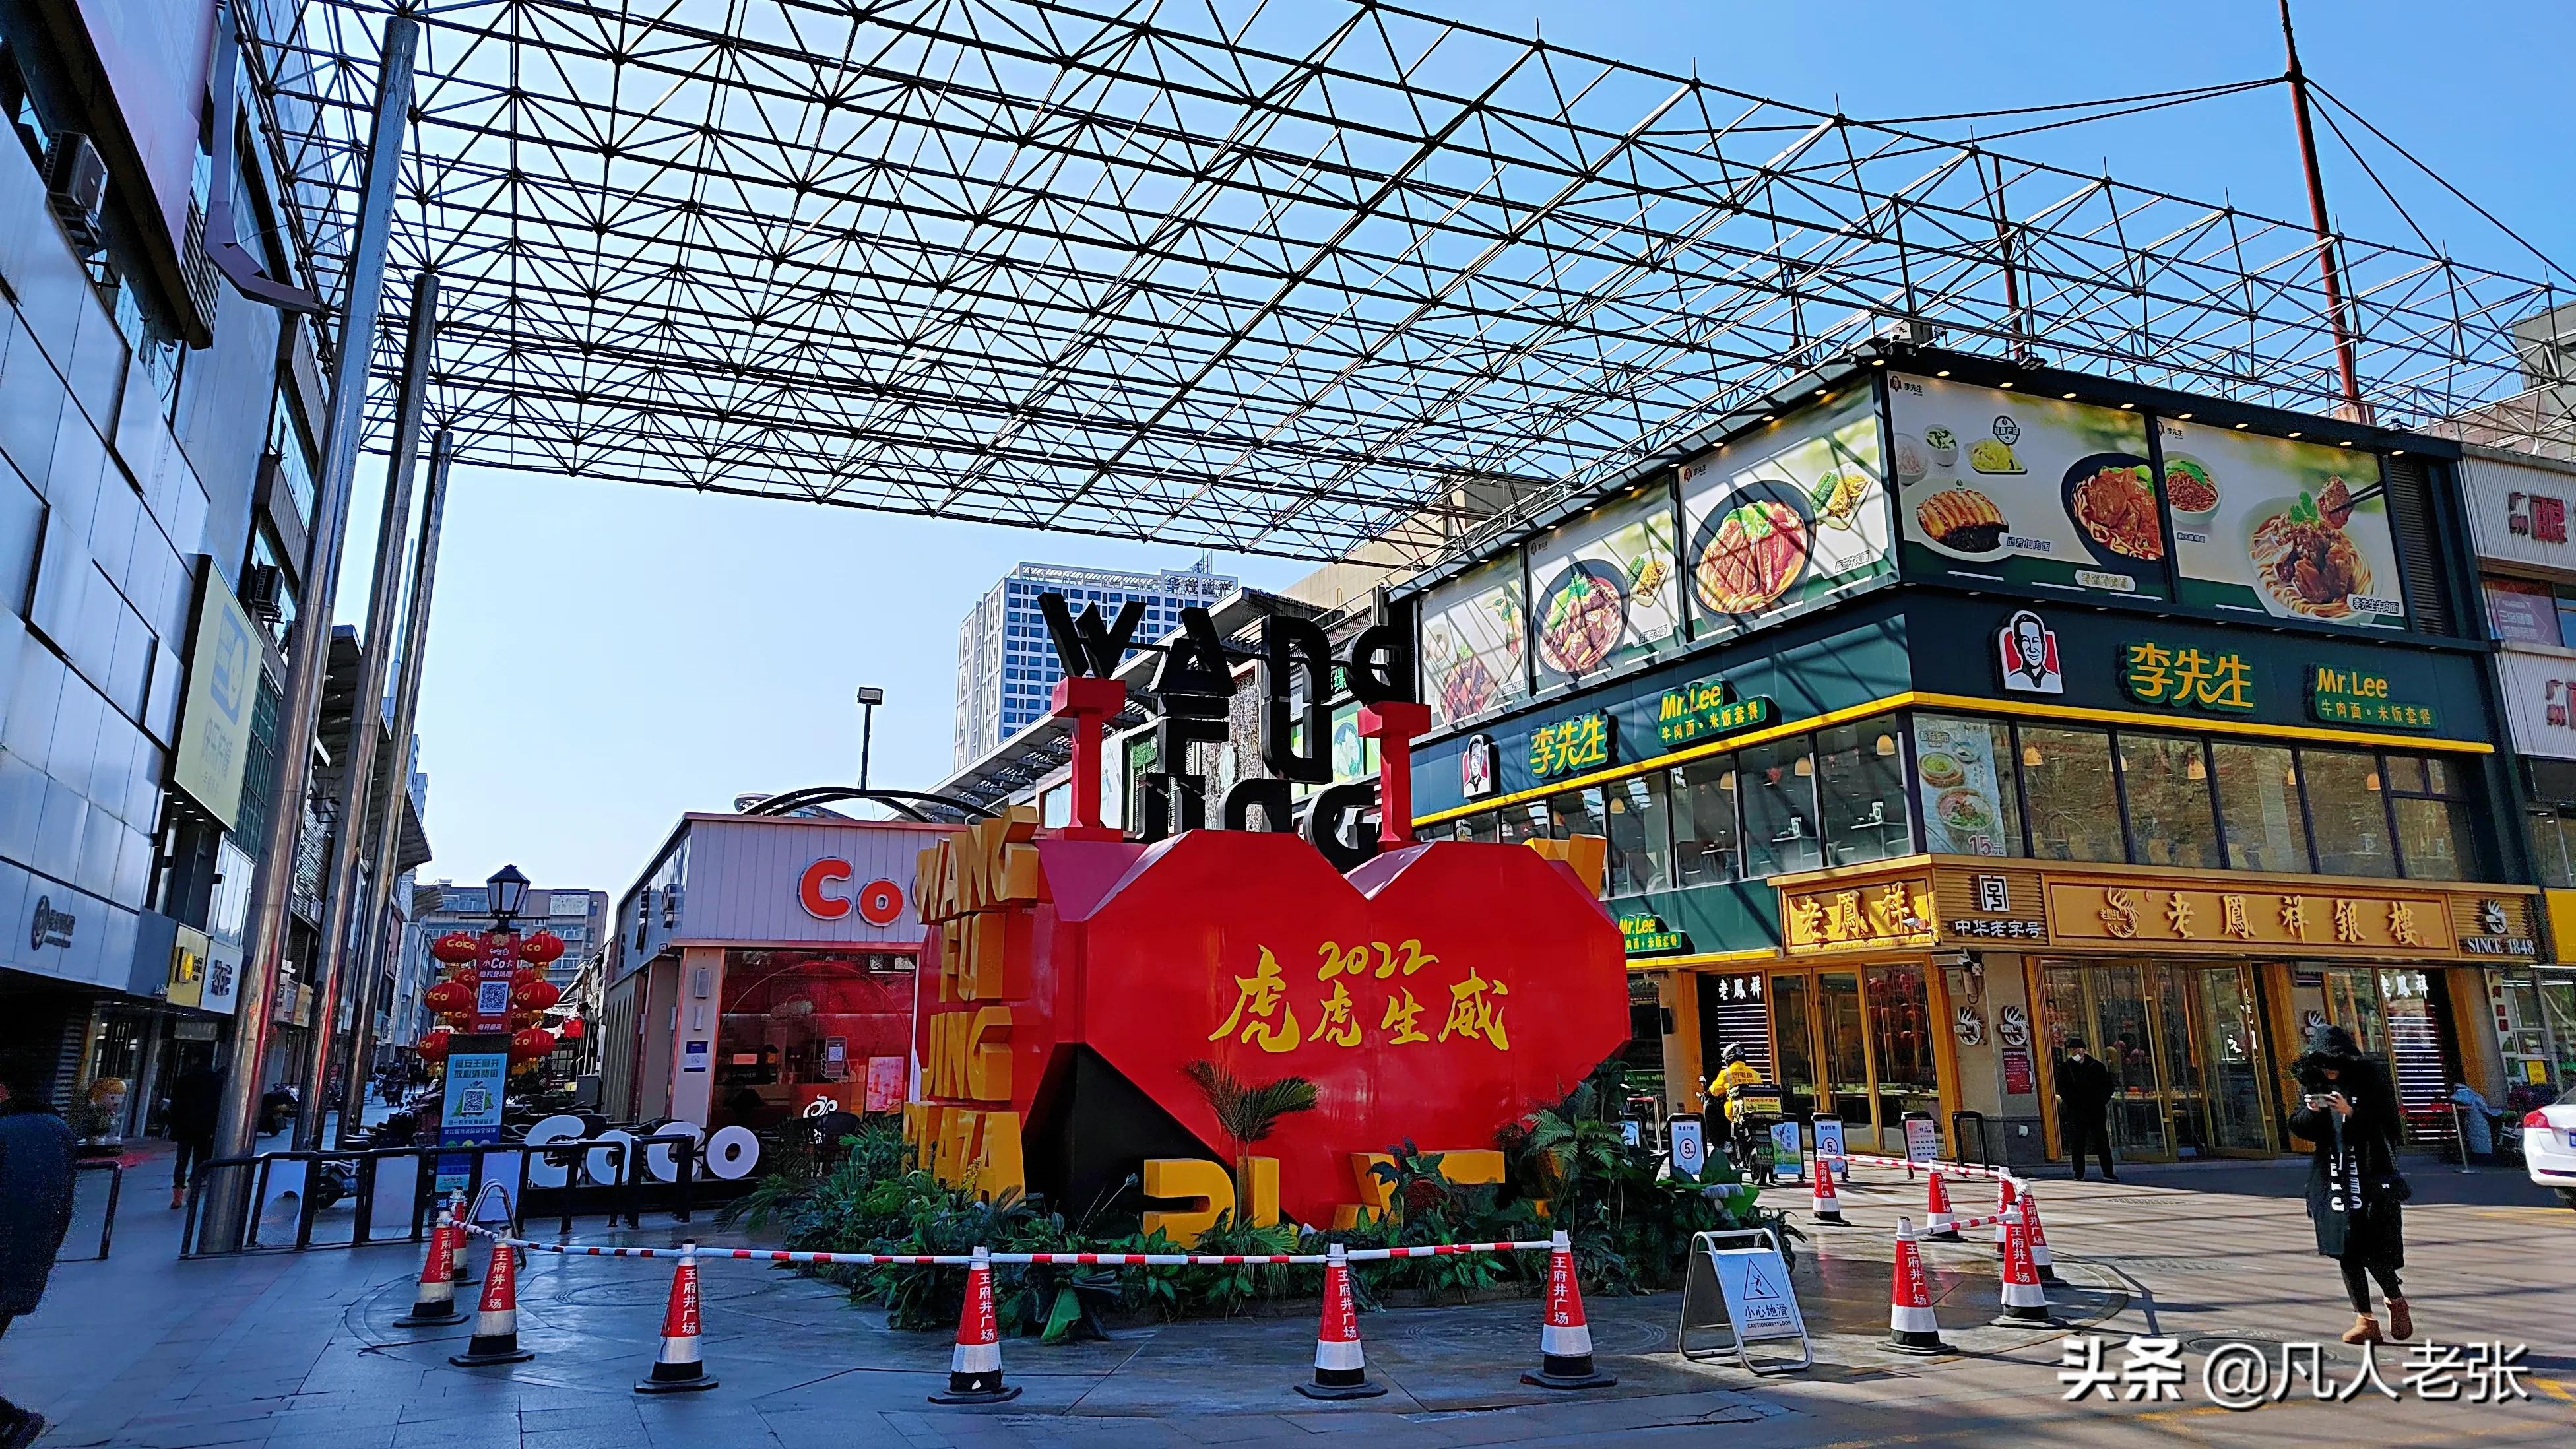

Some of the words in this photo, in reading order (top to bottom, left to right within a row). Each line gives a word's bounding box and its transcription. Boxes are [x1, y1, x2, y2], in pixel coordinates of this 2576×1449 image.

[1904, 383, 1923, 393] 李先生
[2167, 428, 2184, 437] 李先生
[2352, 596, 2399, 614] 李先生牛肉面
[2129, 642, 2255, 709] 李先生
[2317, 668, 2388, 699] Mr.Lee
[1659, 685, 1721, 722] Mr.Lee
[1530, 711, 1610, 779] 李先生
[918, 805, 1039, 923] WANG
[1954, 919, 2042, 939] 中华老字号
[2166, 891, 2422, 948] 老鳳祥銀樓
[2468, 937, 2503, 954] SINCE
[2508, 938, 2535, 955] 1848
[482, 957, 513, 969] 小Co卡
[938, 911, 1006, 1003] FU
[1317, 938, 1440, 980] 2022
[1208, 943, 1509, 1054] 虎虎生威
[920, 1006, 1013, 1101] JING
[1684, 1143, 1691, 1155] 5
[1827, 1141, 1833, 1153] 5
[1819, 1162, 1830, 1198] 王府井广场
[2023, 1196, 2046, 1246] 王府井广场
[439, 1228, 452, 1282] 王府井广场
[488, 1251, 508, 1310] 王府井广场
[1906, 1244, 1927, 1306] 王府井广场
[2011, 1227, 2030, 1283] 王府井广场
[681, 1268, 697, 1335] 王府井广场
[977, 1272, 996, 1342] 王府井广场
[1335, 1262, 1357, 1340] 王府井广场
[1551, 1256, 1570, 1326] 王府井广场
[1745, 1303, 1787, 1320] 小心地滑
